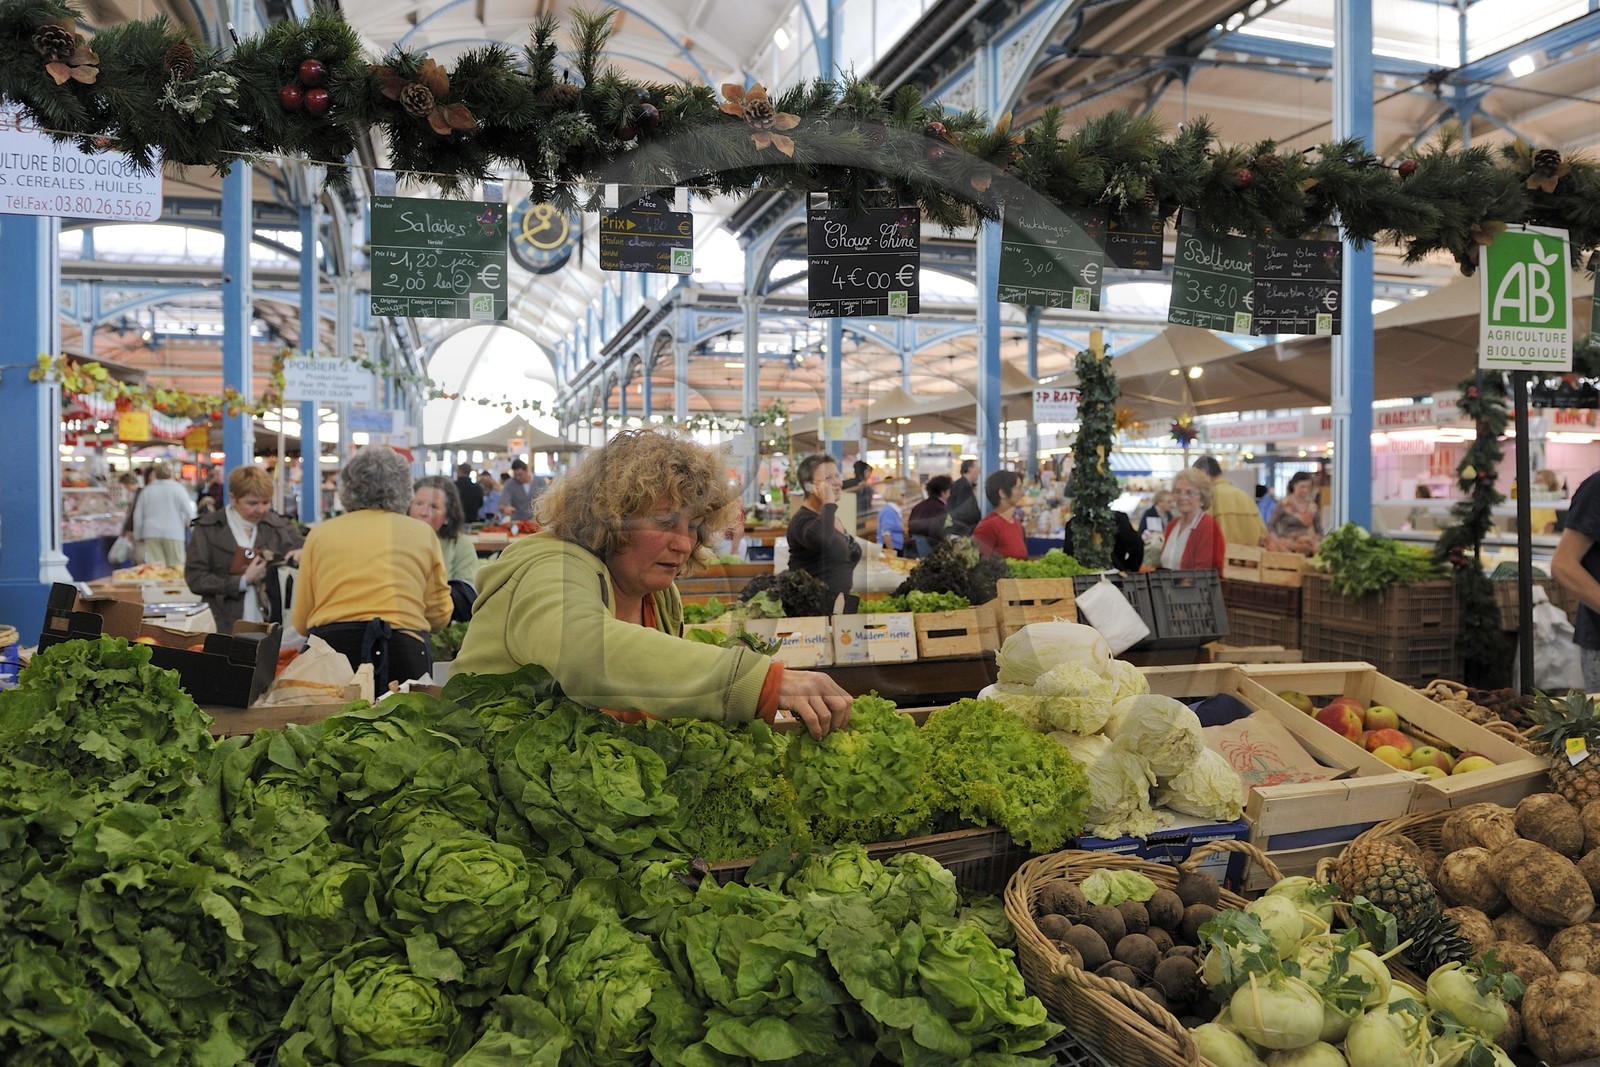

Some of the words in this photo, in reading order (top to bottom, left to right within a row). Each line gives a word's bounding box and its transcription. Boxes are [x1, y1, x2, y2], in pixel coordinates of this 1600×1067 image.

[16, 174, 85, 190] CEREALES
[95, 182, 142, 194] HUILES
[55, 195, 151, 217] 03.80.26.55.62
[638, 198, 657, 208] Pièce
[395, 211, 466, 236] Salades
[601, 215, 625, 229] Prix
[477, 264, 501, 289] €
[895, 264, 915, 287] €
[1080, 262, 1099, 285] €
[1492, 261, 1555, 324] AB
[1487, 330, 1567, 344] AGRICULTURE
[1487, 345, 1567, 359] BIOLOGIQUE
[289, 359, 337, 372] POISIER
[298, 381, 313, 389] Rue
[306, 374, 349, 382] Producteur
[302, 389, 325, 397] 21000
[328, 390, 353, 398] DIJON
